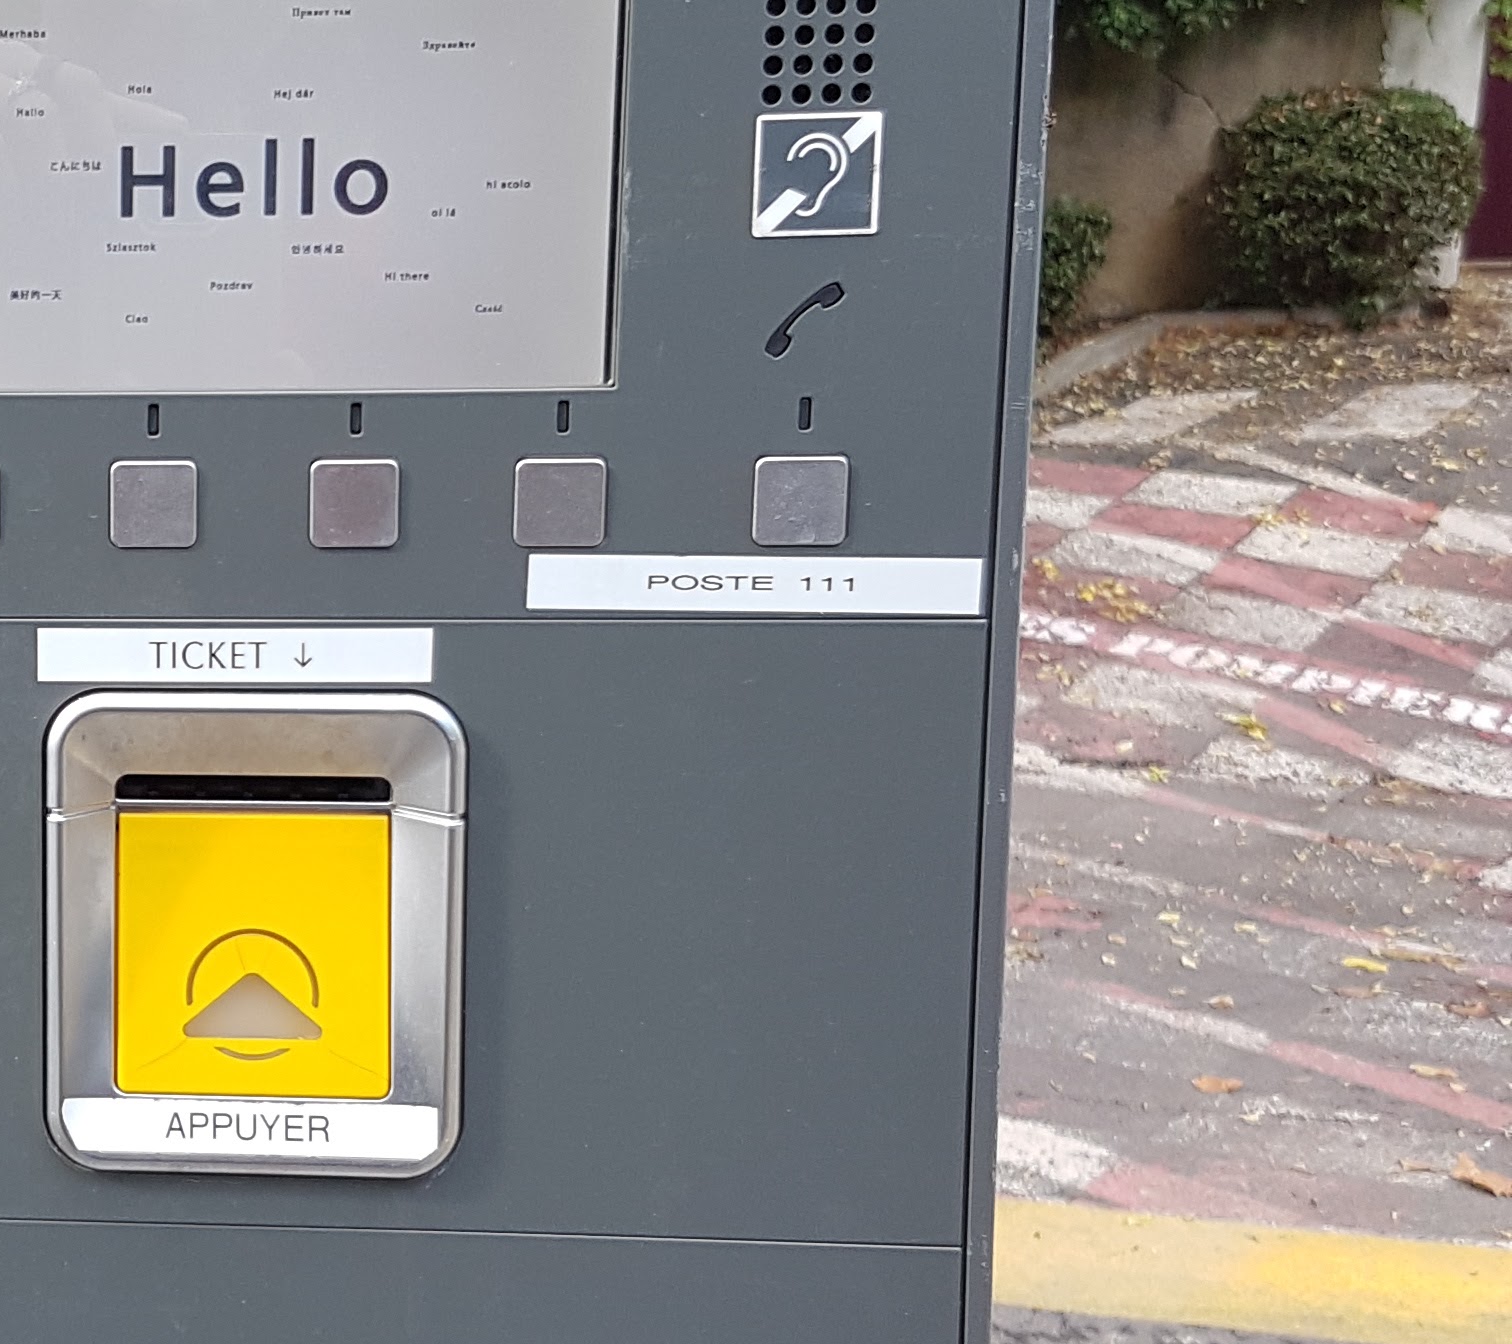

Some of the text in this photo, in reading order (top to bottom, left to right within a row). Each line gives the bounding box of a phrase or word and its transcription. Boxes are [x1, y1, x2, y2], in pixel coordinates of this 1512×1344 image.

[127, 84, 152, 95] Hola
[273, 89, 292, 101] Hej
[16, 107, 45, 118] Hallo
[120, 137, 389, 219] Hello
[106, 242, 156, 253] Sziasztok
[384, 271, 430, 282] Hi there
[209, 281, 254, 291] Pozdrav
[124, 314, 149, 324] Ciao
[647, 574, 855, 592] POSTE 111
[147, 640, 268, 670] TICKET
[165, 1111, 330, 1143] APPUYER
